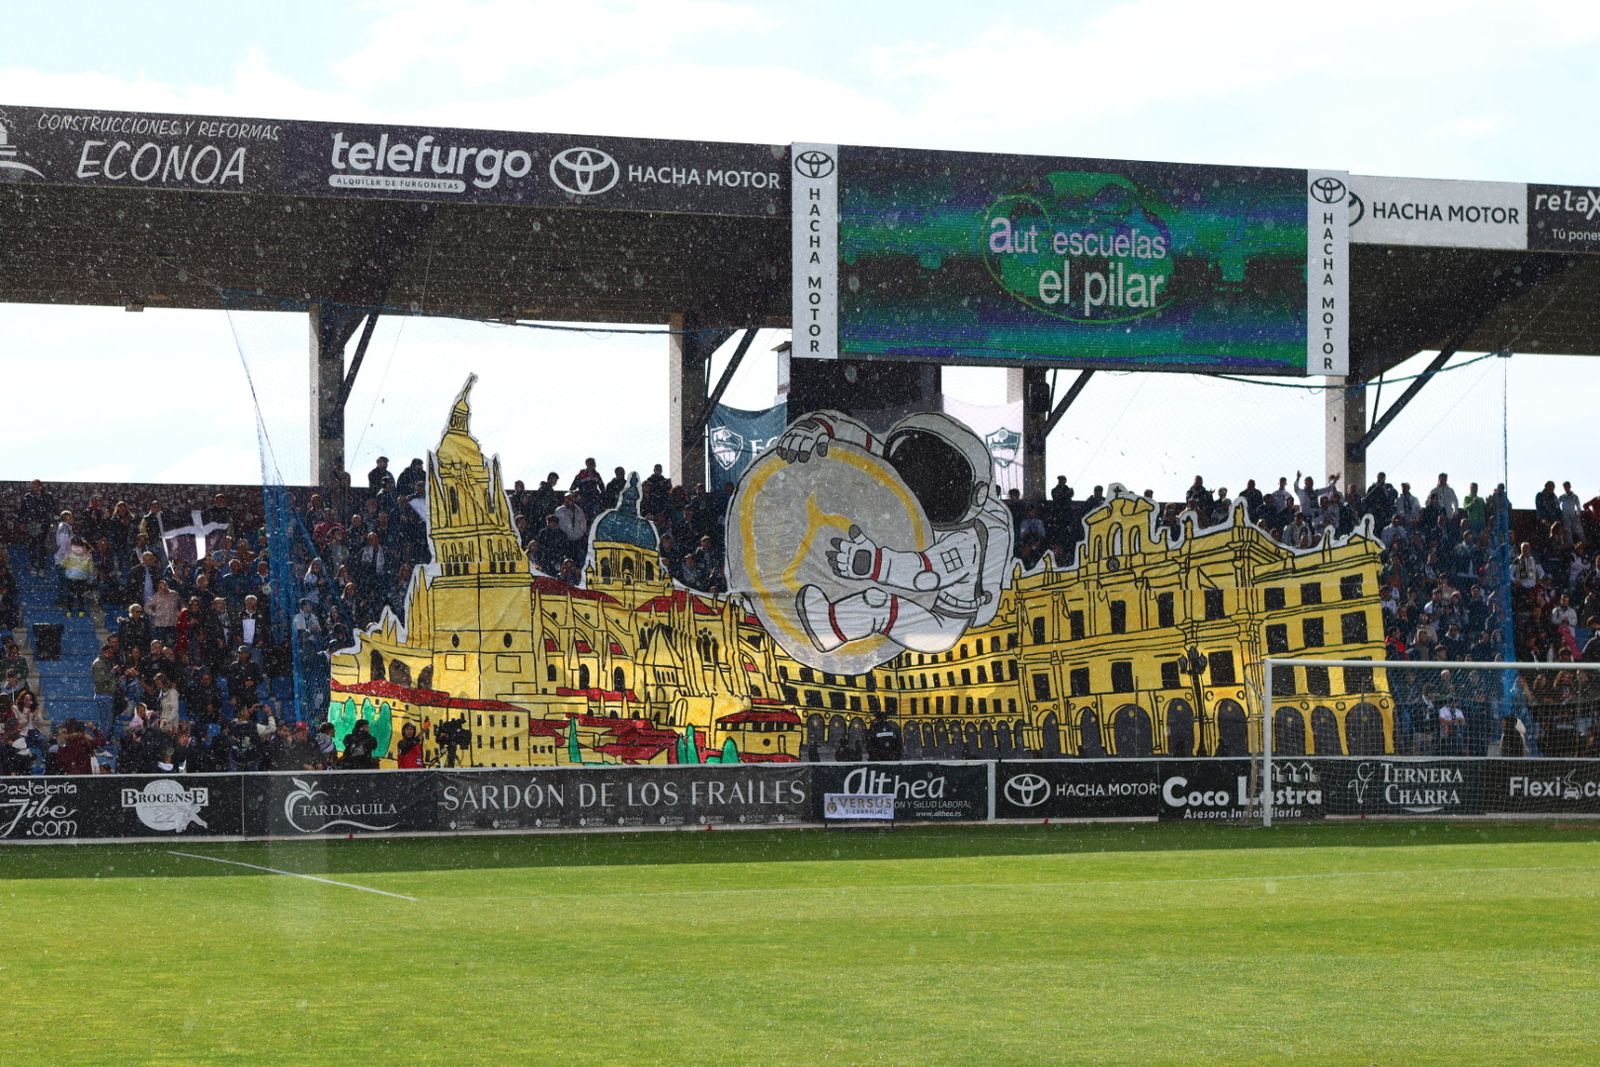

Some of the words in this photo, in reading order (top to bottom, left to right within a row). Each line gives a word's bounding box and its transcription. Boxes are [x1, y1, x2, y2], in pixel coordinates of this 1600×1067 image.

[38, 113, 182, 136] CONSTRUCCIONES
[185, 121, 194, 135] Y
[198, 121, 282, 141] REFORMAS
[76, 140, 247, 184] ECONOA
[331, 132, 532, 189] telefurgo
[336, 178, 381, 186] ALQUILER
[385, 179, 396, 187] DE
[399, 180, 459, 190] FURGONETAS
[628, 164, 701, 186] HACHA
[706, 169, 781, 190] MOTOR
[1373, 202, 1443, 221] HACHA
[1448, 206, 1519, 225] MOTOR
[808, 188, 822, 264] HACHA
[1552, 227, 1566, 239] Tú
[1053, 228, 1166, 258] escuelas
[1323, 213, 1334, 286] HACHA
[1039, 260, 1070, 304] el
[1084, 262, 1165, 317] pilar
[807, 277, 822, 352] MOTOR
[1321, 297, 1335, 370] MOTOR
[1381, 764, 1464, 783] TERNERA
[443, 777, 564, 811] SARDÓN
[580, 783, 615, 808] DE
[627, 782, 679, 806] LOS
[691, 779, 806, 805] FRAILES
[1056, 784, 1105, 795] HACHA
[1108, 783, 1157, 795] MOTOR
[1162, 776, 1229, 807] Coco
[1385, 784, 1461, 804] CHARRA
[1510, 777, 1561, 797] Flexi
[300, 803, 398, 816] TARDAGUILA
[840, 798, 892, 809] VERSUS
[906, 801, 911, 809] Y
[938, 800, 972, 809] LABORAL
[1184, 809, 1228, 819] Asesora
[1231, 807, 1301, 818] Inmobliaria
[26, 820, 78, 836] .com
